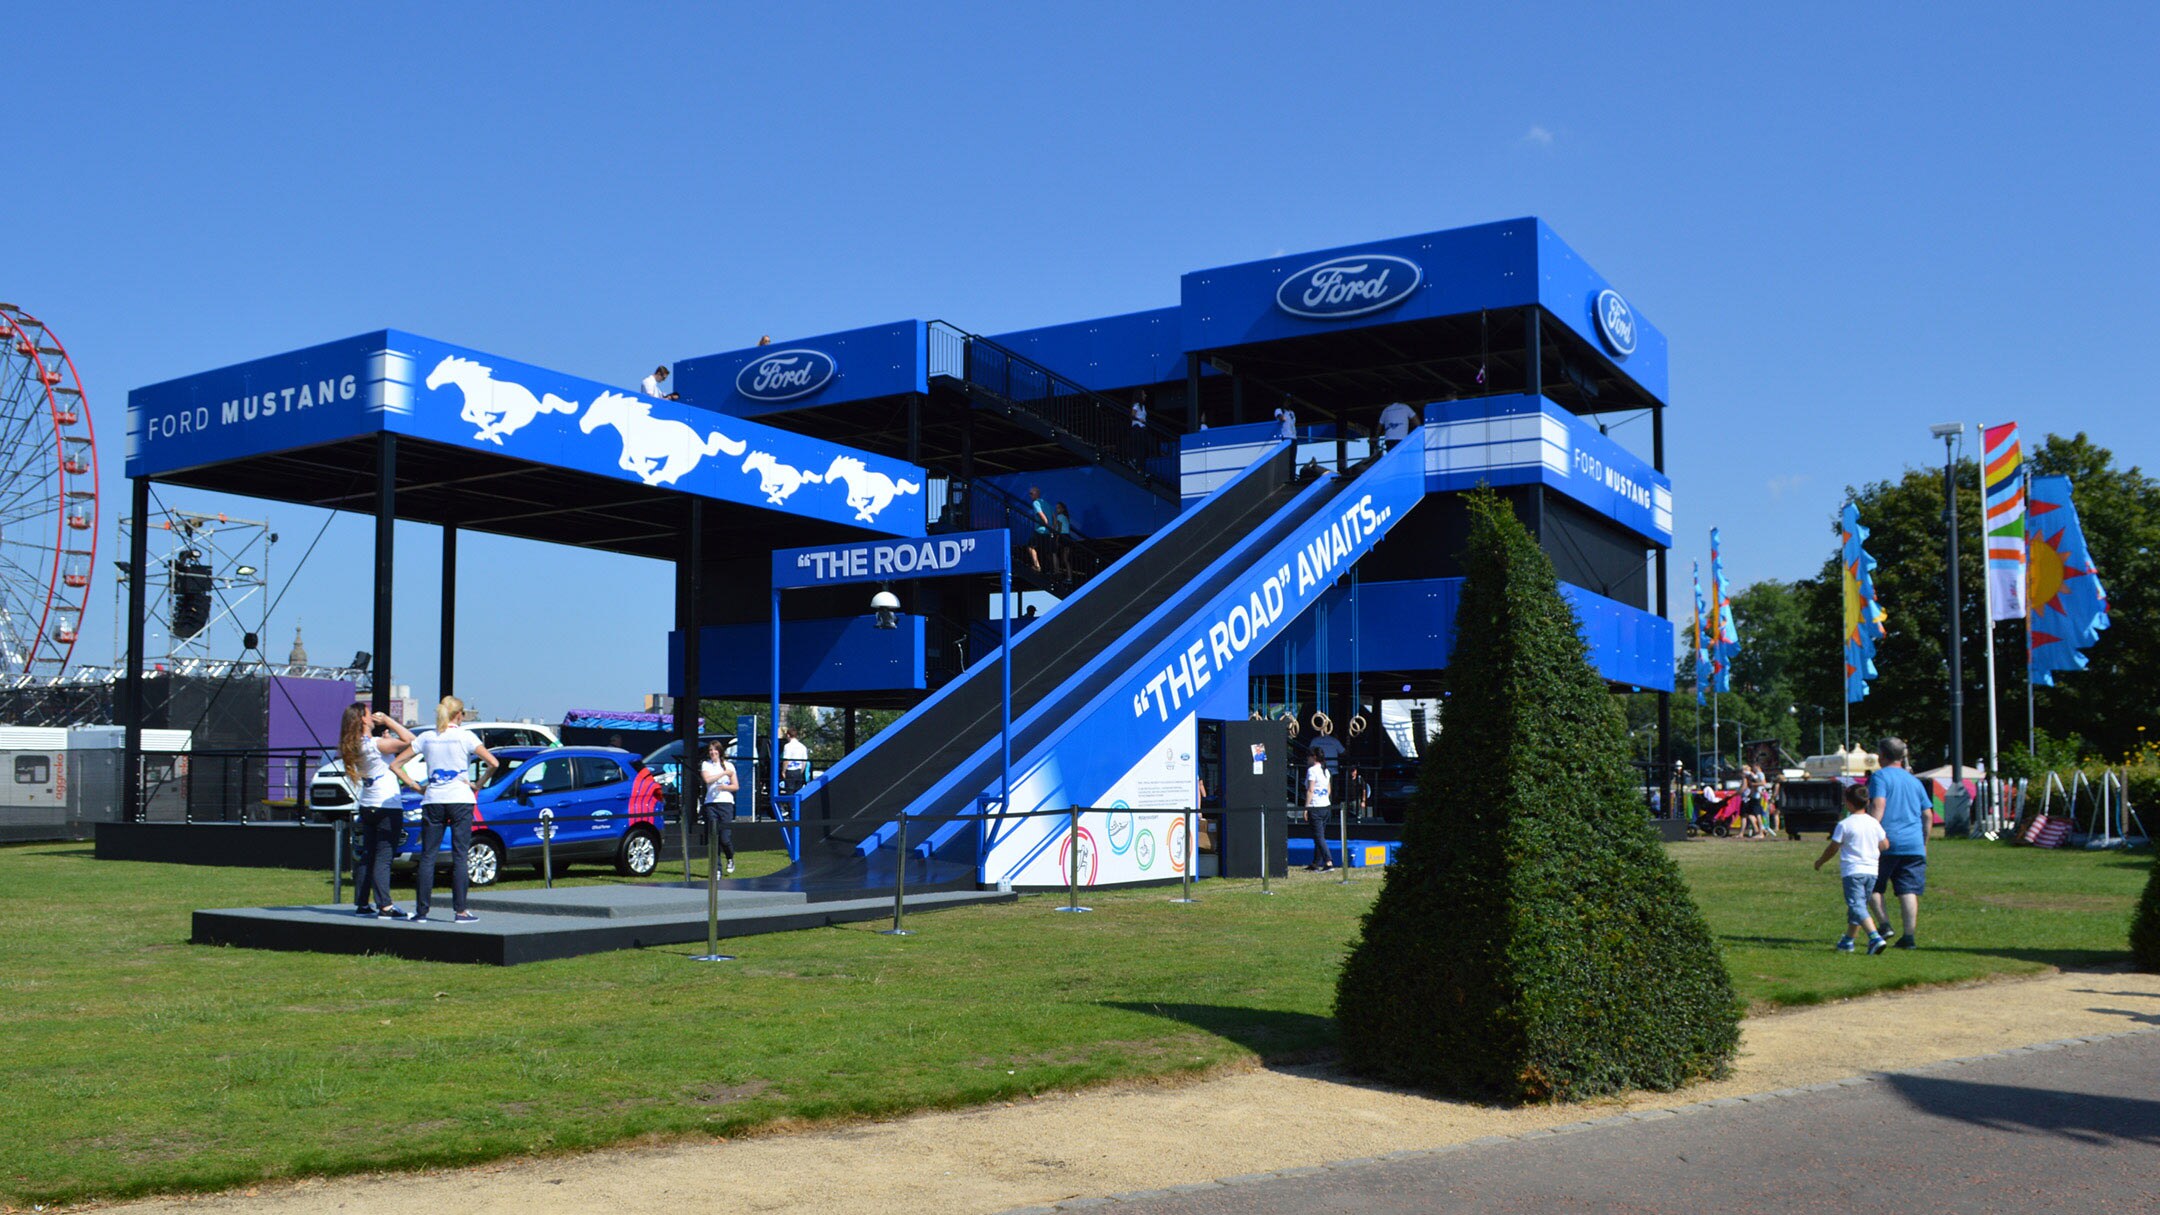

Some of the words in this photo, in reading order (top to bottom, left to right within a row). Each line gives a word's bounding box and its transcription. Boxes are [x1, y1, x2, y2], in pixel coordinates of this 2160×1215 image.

[1303, 264, 1390, 307] Ford
[1607, 297, 1632, 344] Ford
[752, 357, 813, 391] Ford
[148, 406, 209, 441] FORD
[221, 374, 356, 425] MUSTANG
[1573, 447, 1603, 481] FORD
[1605, 466, 1651, 510] MUSTANG
[1297, 494, 1391, 597] AWAITS...
[54, 753, 67, 800] aggreko
